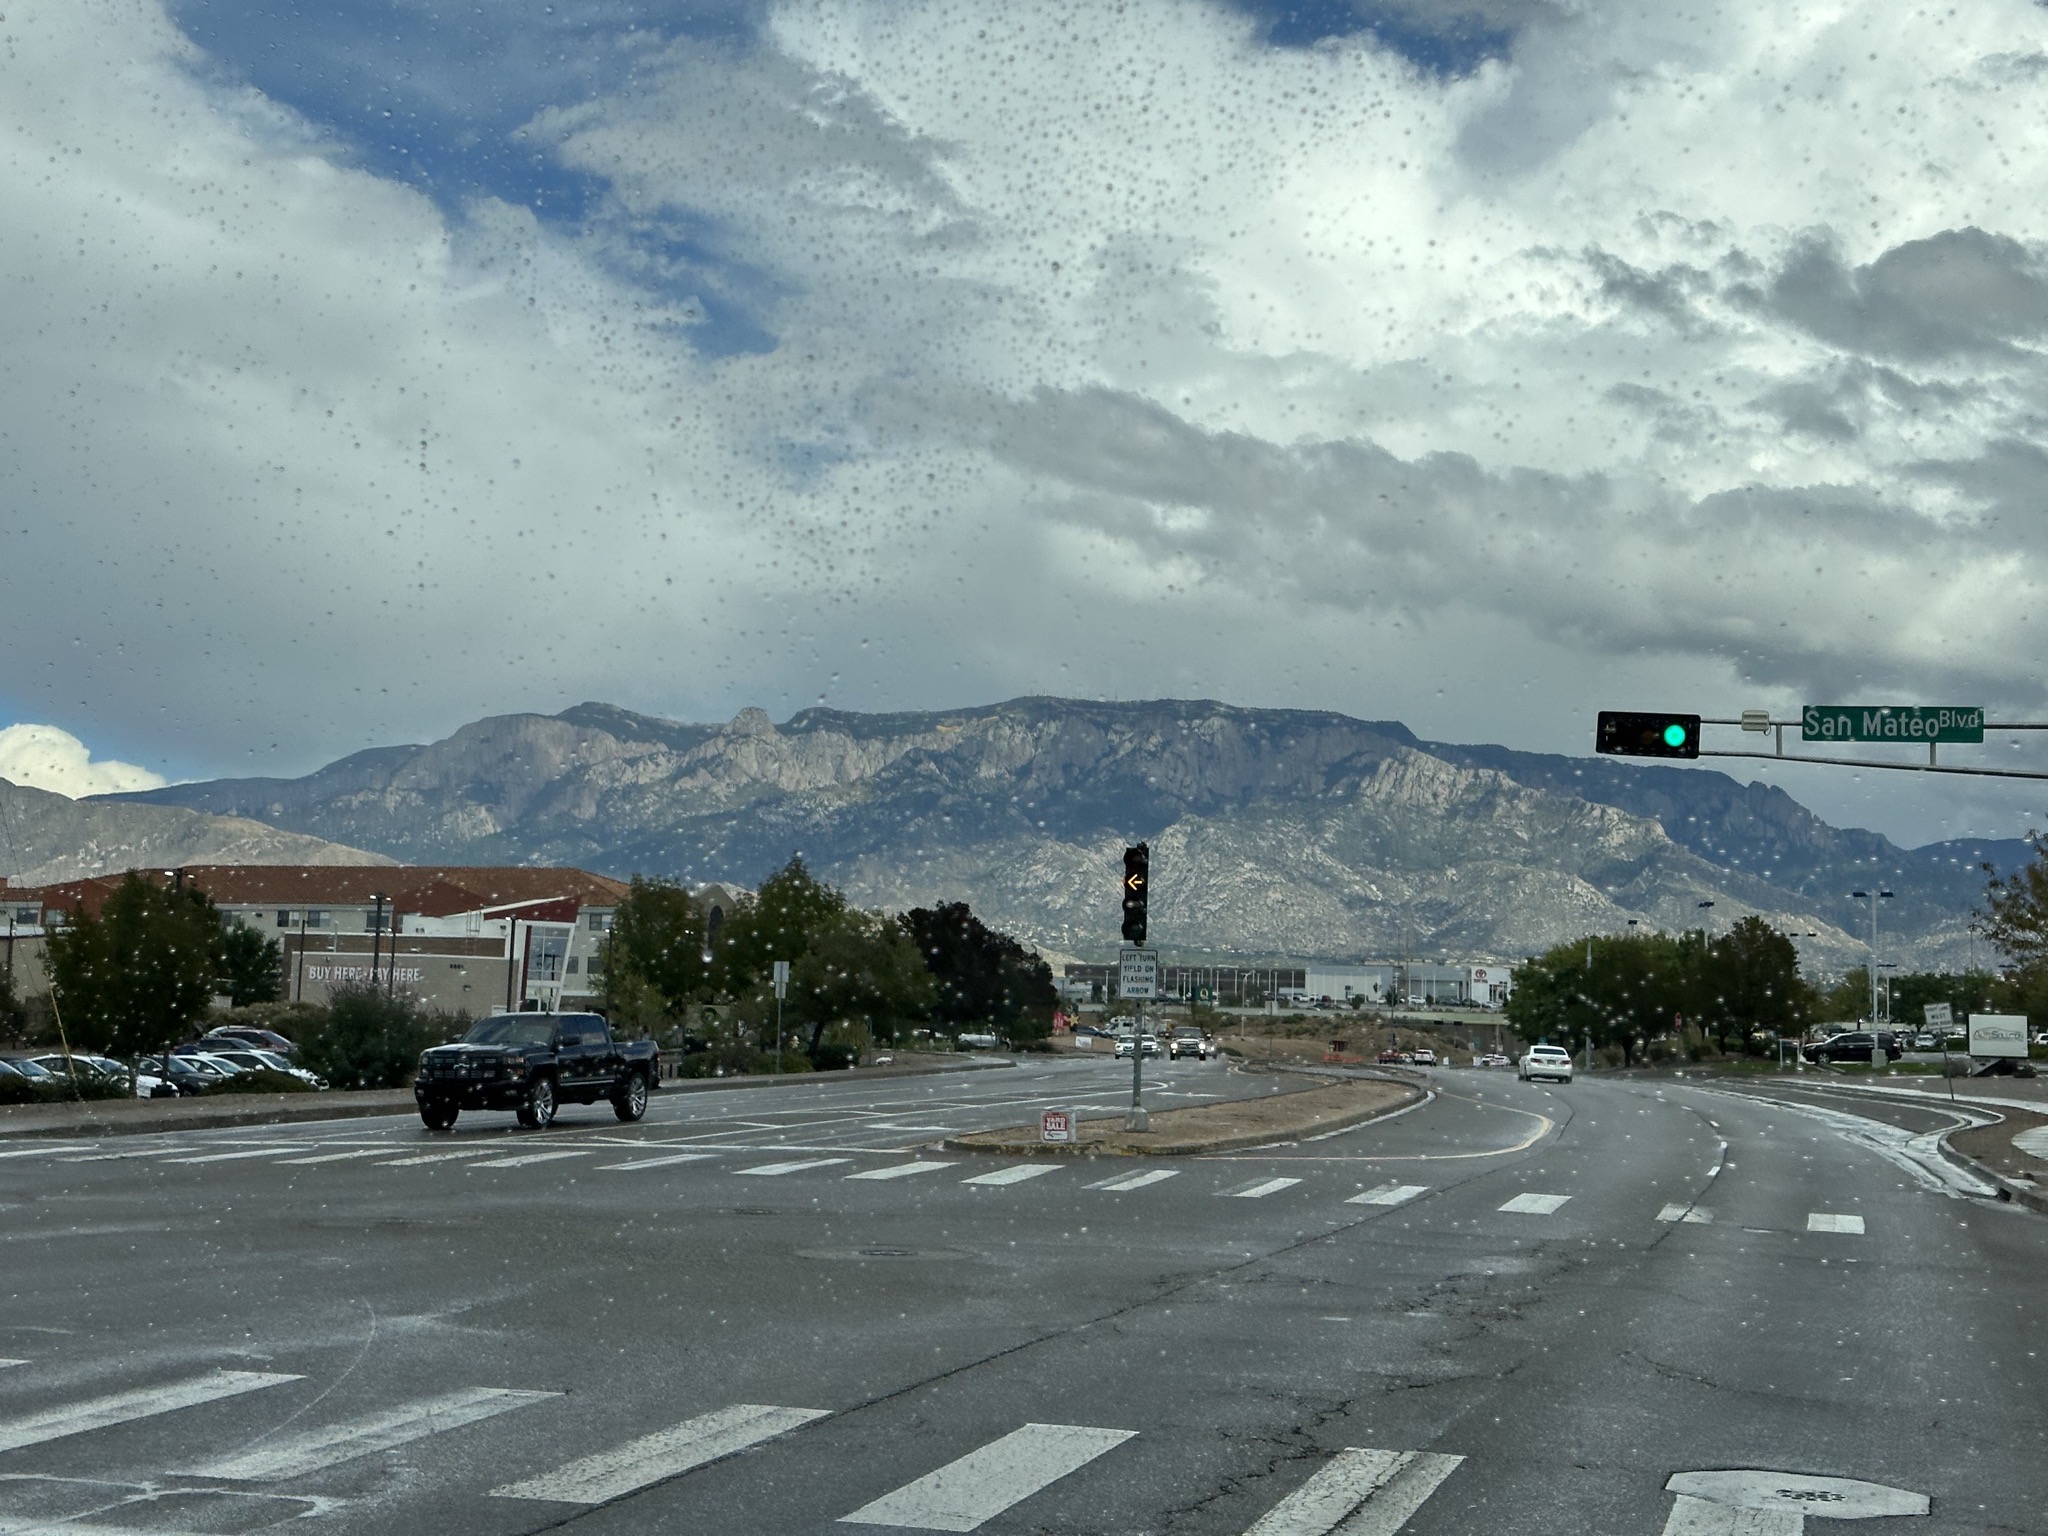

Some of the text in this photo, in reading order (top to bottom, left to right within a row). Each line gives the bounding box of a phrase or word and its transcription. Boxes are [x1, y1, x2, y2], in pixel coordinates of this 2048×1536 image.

[1804, 710, 1978, 737] San Mateo Blvd
[1122, 954, 1137, 962] LEFT
[309, 966, 331, 979] BUY
[334, 967, 362, 980] HERE
[392, 967, 420, 981] HERE
[1127, 986, 1149, 994] ARROW
[1046, 1121, 1066, 1130] SALE
